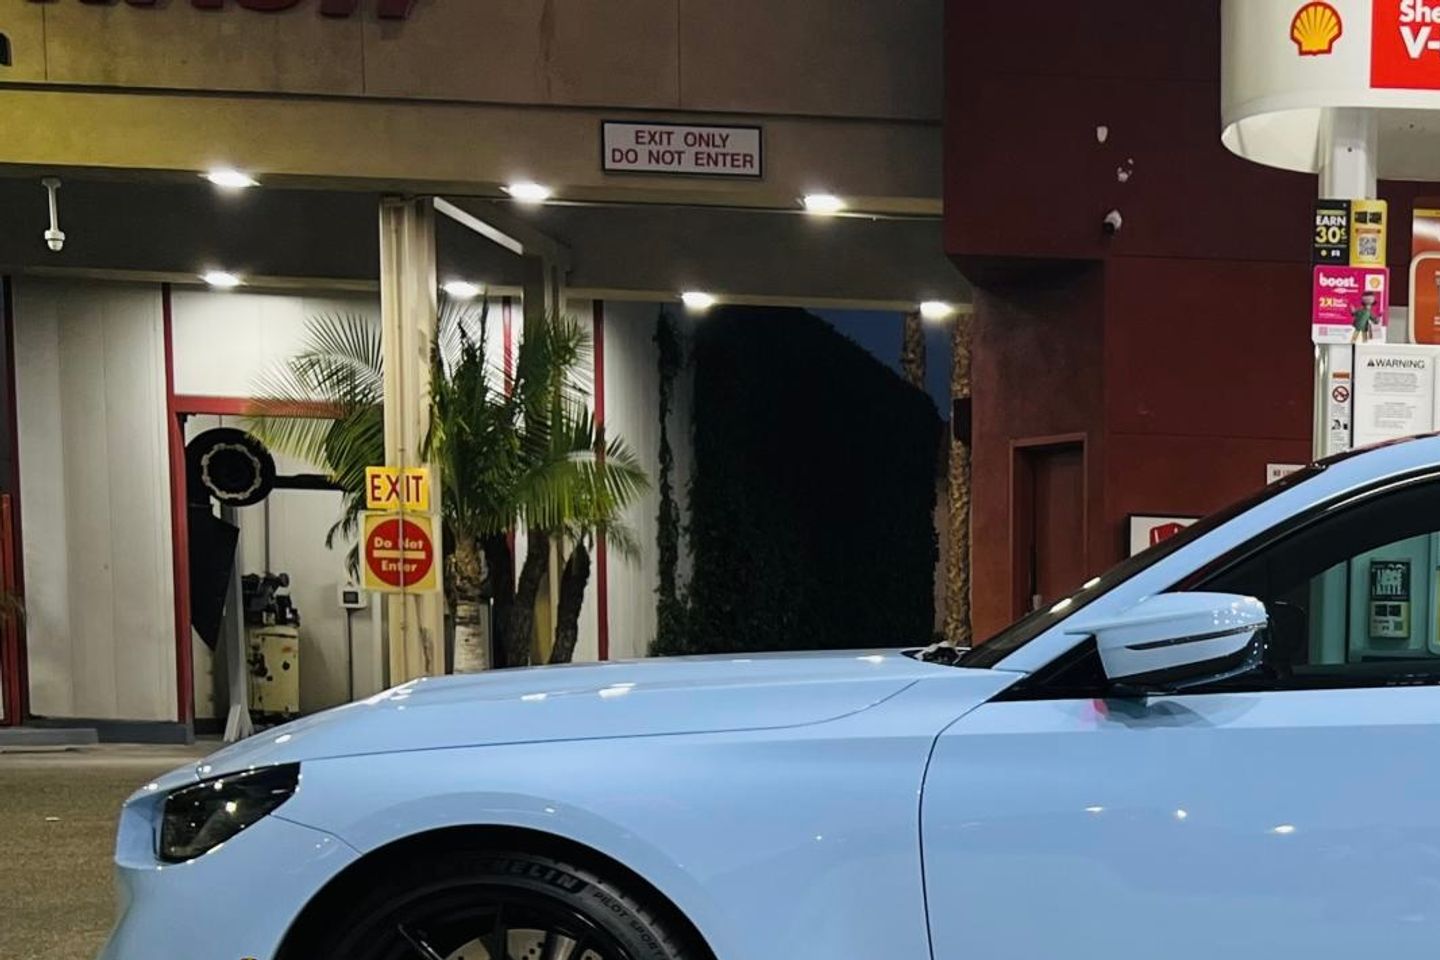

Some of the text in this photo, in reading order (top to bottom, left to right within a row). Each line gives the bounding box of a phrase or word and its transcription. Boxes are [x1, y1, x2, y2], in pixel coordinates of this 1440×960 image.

[635, 130, 730, 148] EXIT ONLY
[612, 149, 754, 169] DO NOT ENTER
[1316, 216, 1346, 226] EARN
[1375, 359, 1425, 369] WARNING
[370, 474, 423, 503] EXIT
[373, 537, 392, 549] Do
[381, 560, 417, 572] Enter
